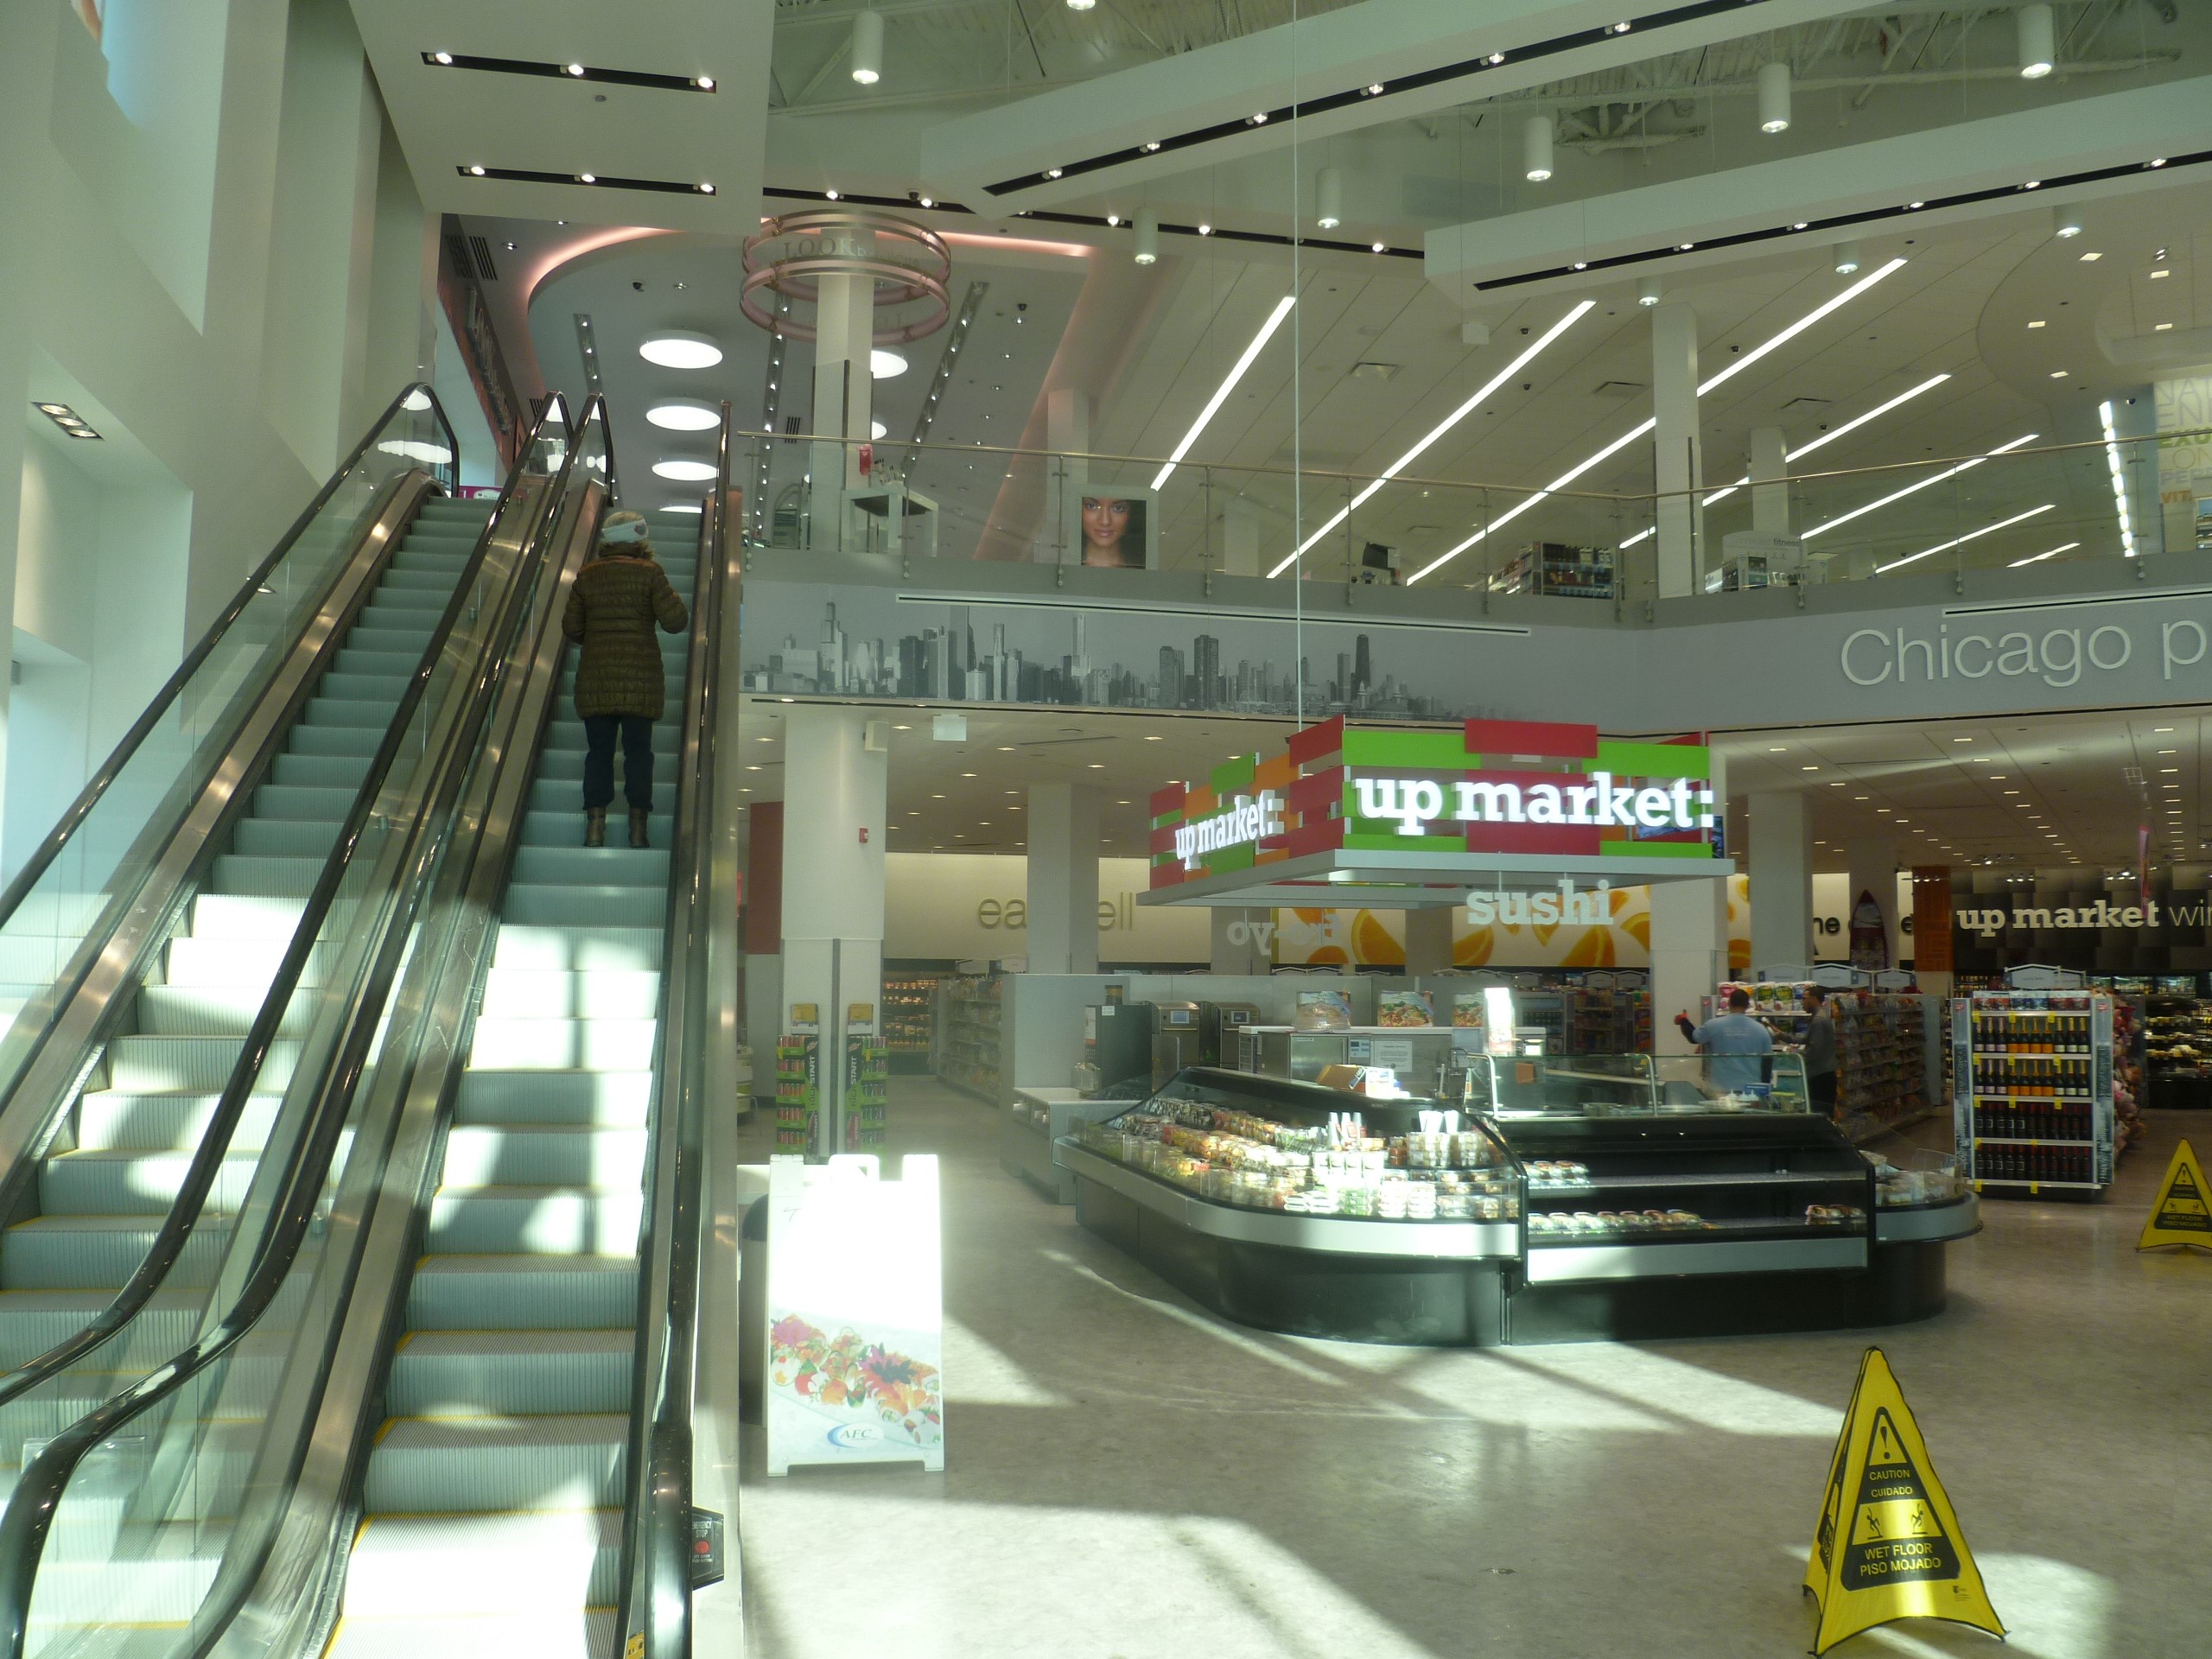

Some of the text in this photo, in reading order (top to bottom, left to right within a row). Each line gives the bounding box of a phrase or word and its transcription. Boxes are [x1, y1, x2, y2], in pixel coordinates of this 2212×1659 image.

[1840, 624, 2132, 687] Chicago
[1351, 777, 1444, 836] up
[1175, 824, 1201, 871] up
[977, 897, 1027, 930] ea
[1467, 880, 1614, 925] sushi
[1956, 908, 2006, 938] up
[2012, 899, 2160, 929] market
[840, 1428, 872, 1439] AFC
[1869, 1469, 1910, 1481] CAUTION
[1871, 1486, 1913, 1497] CUIDADO
[696, 1529, 709, 1538] STOP
[1865, 1542, 1933, 1560] WET FLOOR
[1859, 1557, 1942, 1577] PISO MOJADO
